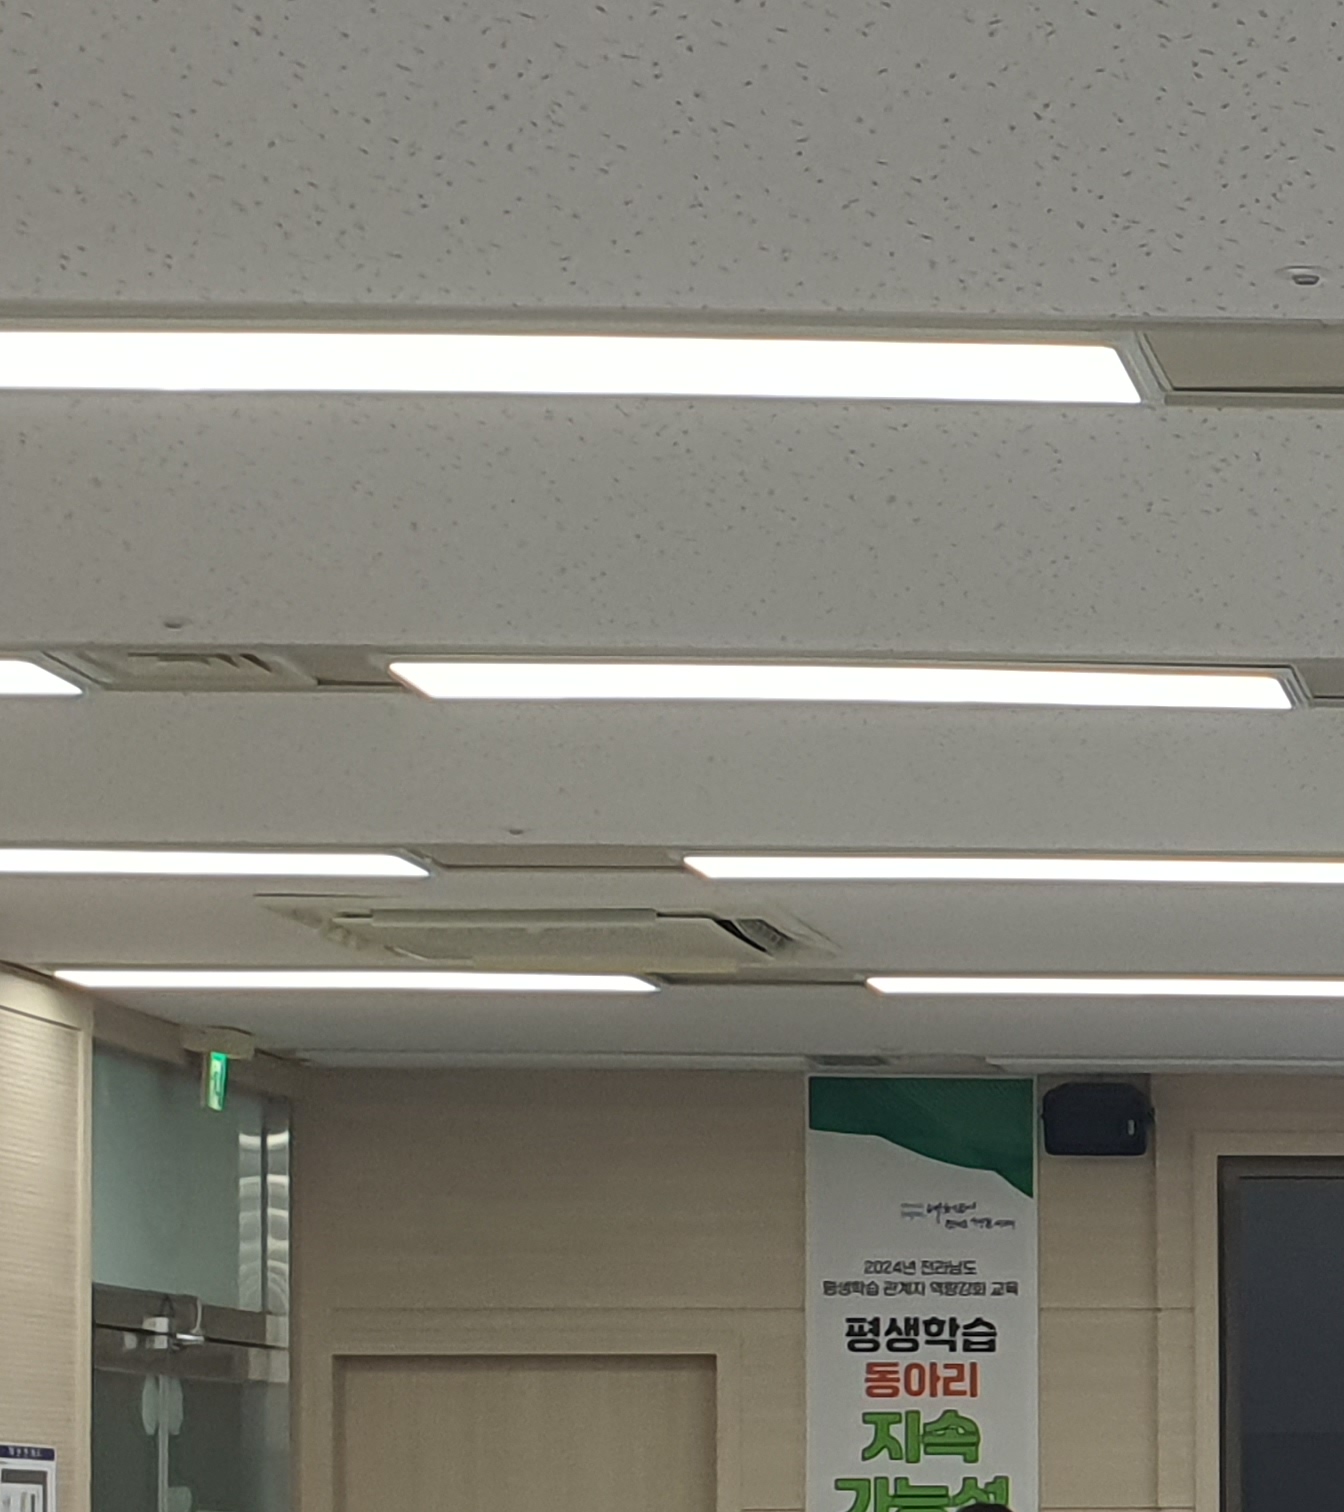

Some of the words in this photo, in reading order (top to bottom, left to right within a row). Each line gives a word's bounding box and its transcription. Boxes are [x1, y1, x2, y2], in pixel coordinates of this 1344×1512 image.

[844, 1316, 998, 1352] 평생학습
[864, 1361, 979, 1398] 동아리
[861, 1409, 981, 1464] 지속
